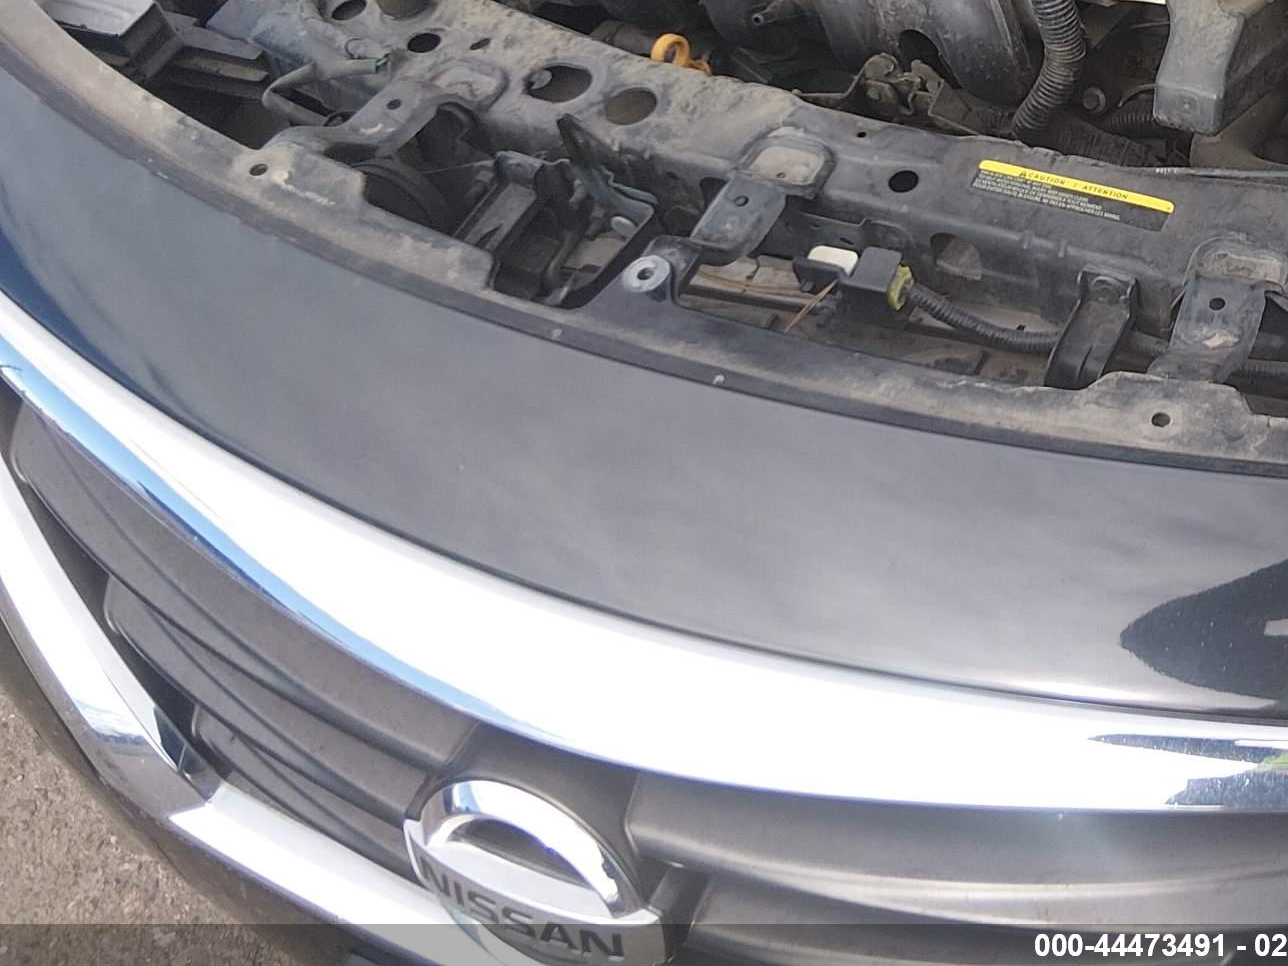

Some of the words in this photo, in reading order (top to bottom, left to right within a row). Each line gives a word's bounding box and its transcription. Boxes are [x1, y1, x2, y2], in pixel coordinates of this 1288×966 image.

[1029, 173, 1065, 185] CAUTION
[1083, 185, 1128, 200] ATTENTION
[419, 855, 625, 957] NISSAN
